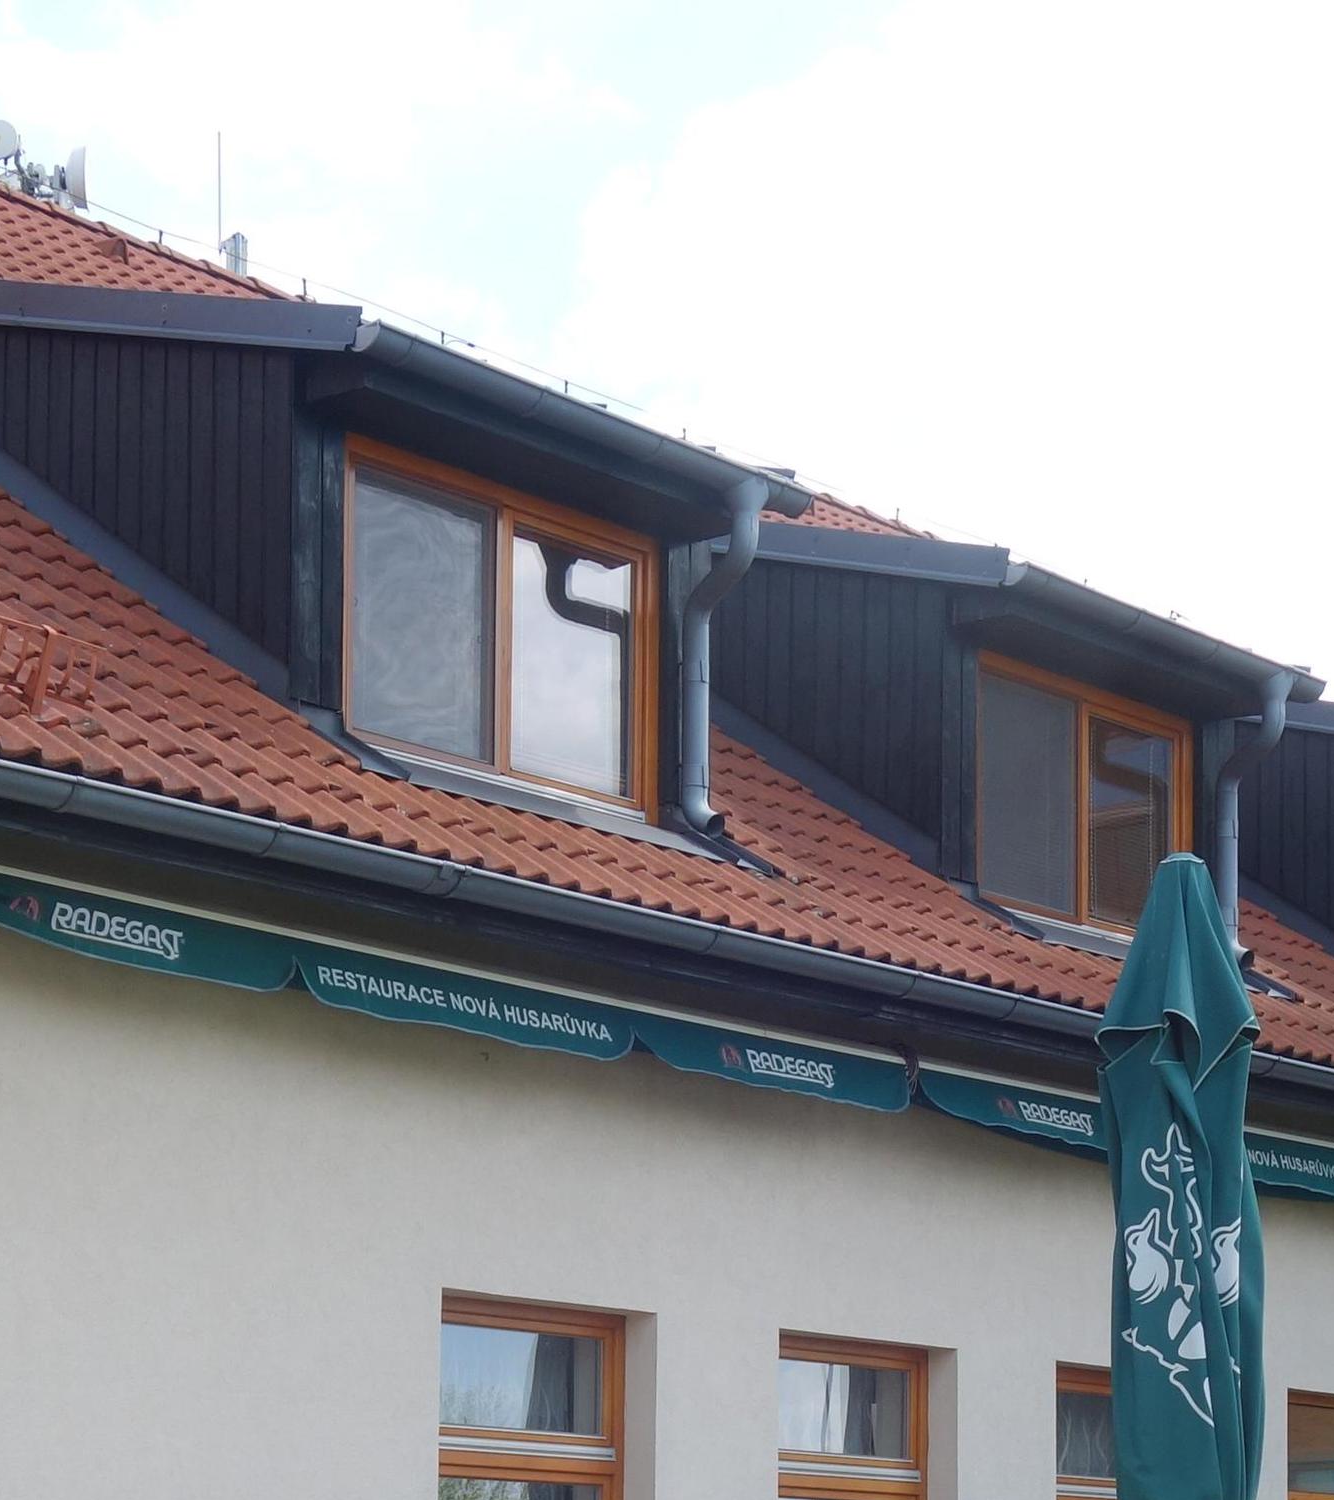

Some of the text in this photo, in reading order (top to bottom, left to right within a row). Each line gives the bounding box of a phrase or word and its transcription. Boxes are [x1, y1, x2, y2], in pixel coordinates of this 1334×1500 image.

[51, 902, 183, 960] RADEGAST
[317, 965, 614, 1043] RESTAURACE NOVÁ HUSARŮVKA
[746, 1048, 835, 1089] RADEGAST
[1018, 1100, 1094, 1137] RADEGAST
[1247, 1148, 1279, 1168] NOVÁ
